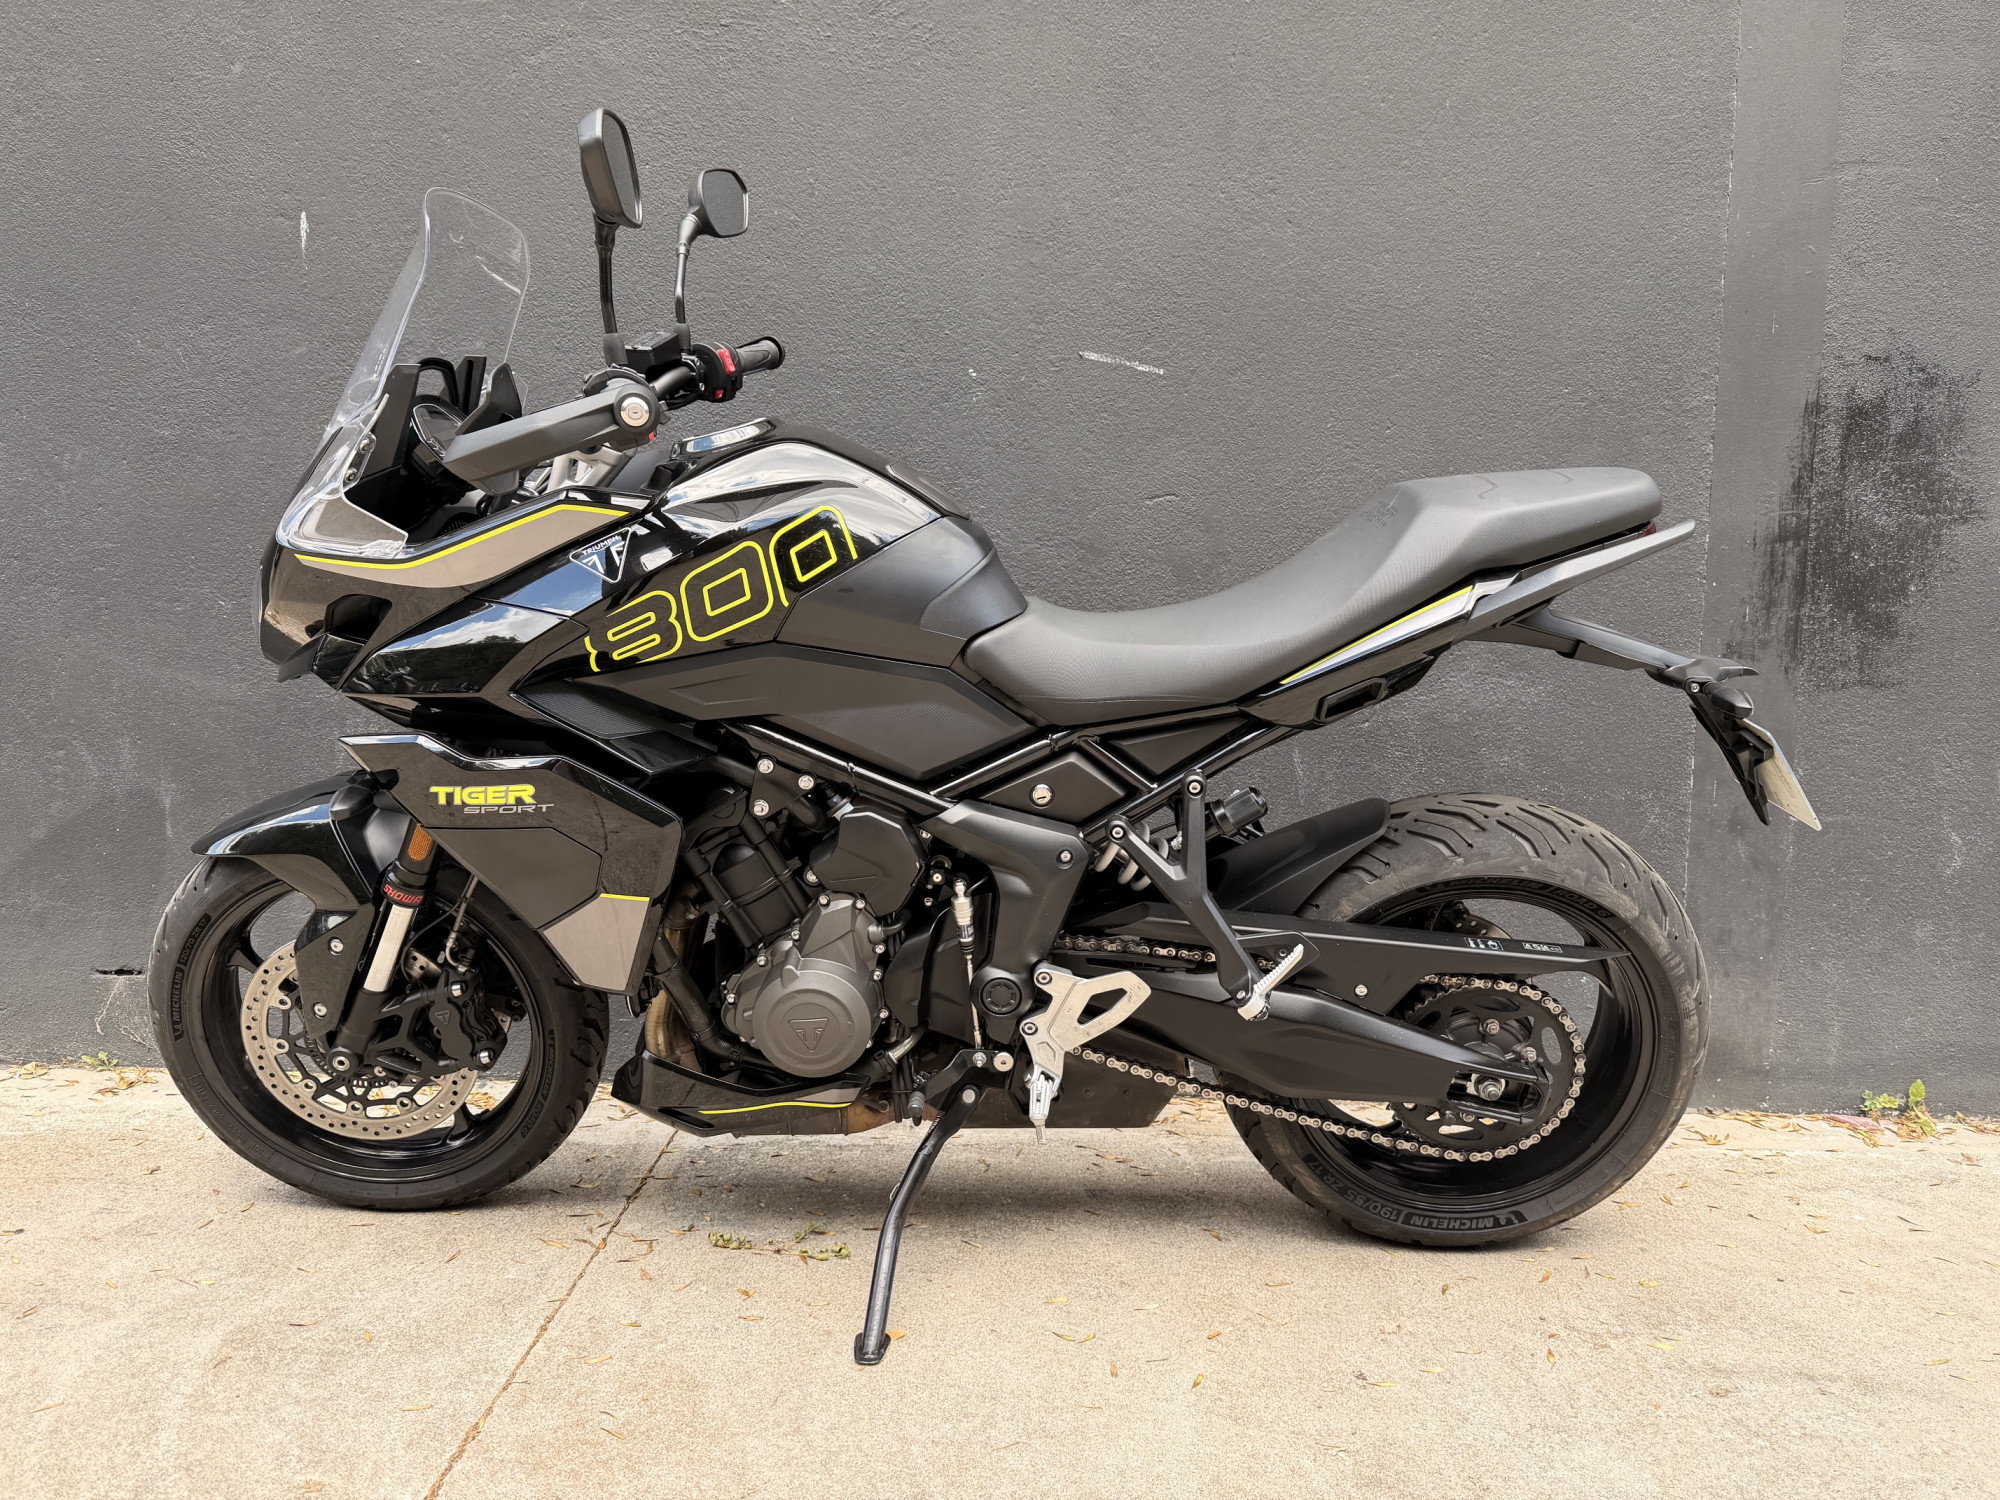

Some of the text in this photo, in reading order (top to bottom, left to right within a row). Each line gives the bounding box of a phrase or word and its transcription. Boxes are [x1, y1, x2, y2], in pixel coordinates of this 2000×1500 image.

[581, 534, 623, 556] TRIUMPH
[584, 505, 858, 672] 800
[429, 784, 536, 806] TIGER
[463, 803, 555, 814] SPORT
[383, 884, 425, 905] SHOWA
[1447, 876, 1610, 918] MICHELIN ROAD 6
[172, 918, 208, 1021] MICHELIN 120/70 ZR 17
[1307, 1160, 1494, 1229] MICHELIN 190/55 ZR 17
